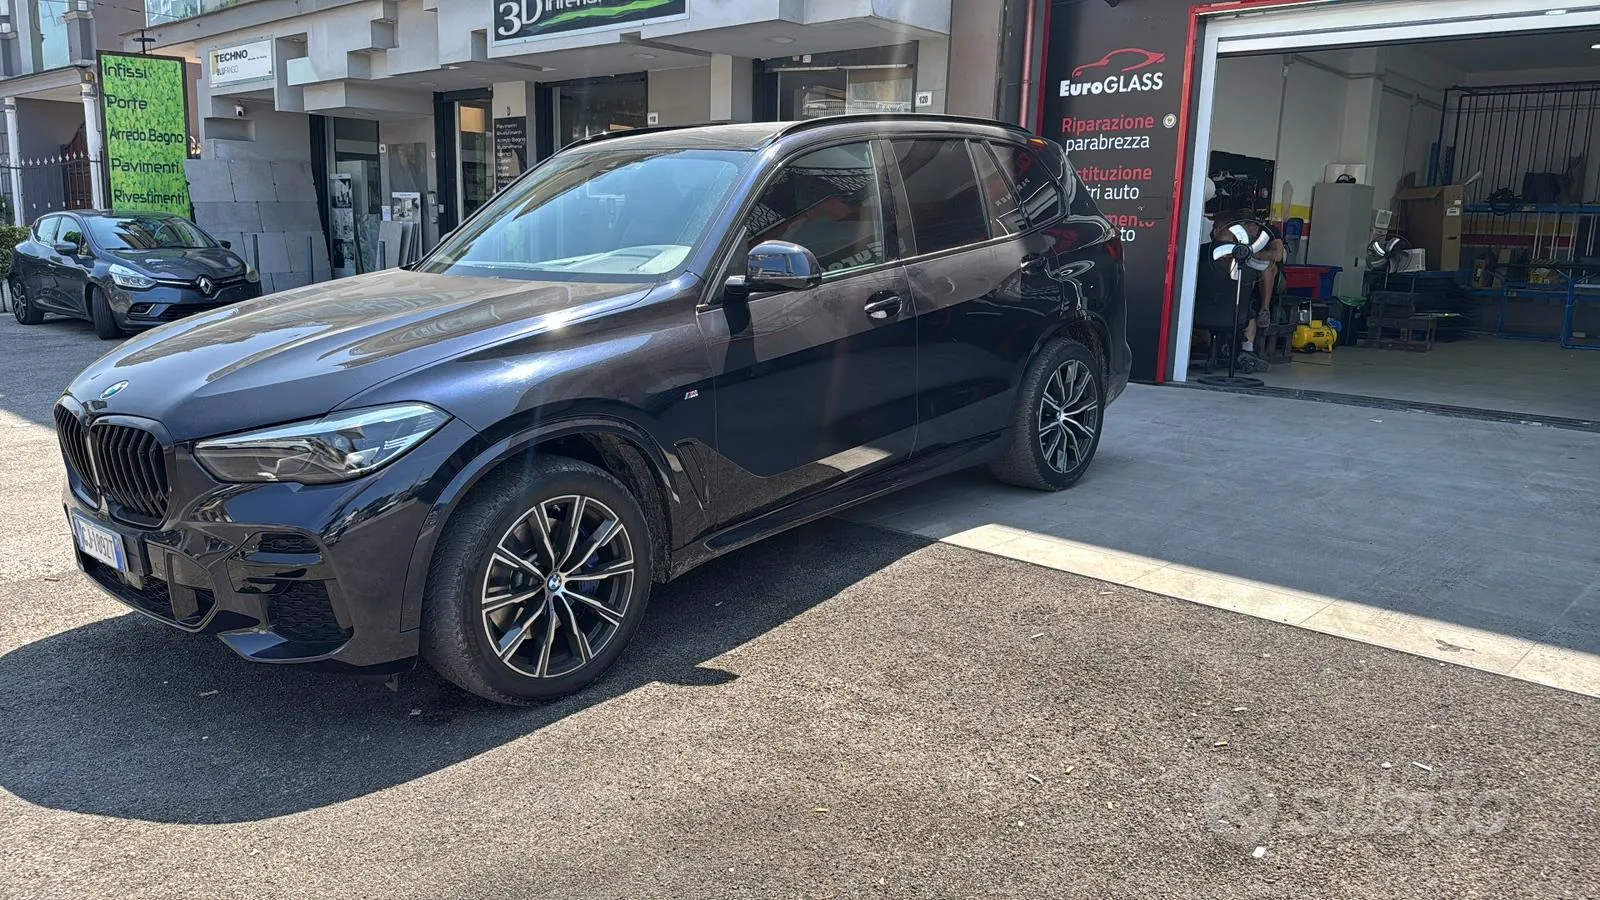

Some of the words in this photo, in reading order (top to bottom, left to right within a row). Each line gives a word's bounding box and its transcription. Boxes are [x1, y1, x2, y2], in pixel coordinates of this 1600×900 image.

[498, 0, 543, 36] 3D
[214, 49, 248, 63] TECHNO
[104, 62, 147, 79] Infissi
[1059, 72, 1164, 97] EuroGLASS
[105, 94, 148, 110] Porte
[919, 95, 929, 104] 120
[1062, 114, 1155, 136] Riparazione
[109, 127, 147, 142] Arredo
[148, 129, 184, 146] Bagno
[1066, 133, 1151, 156] parabrezza
[111, 157, 180, 174] Pavimenti
[114, 189, 185, 205] Rivestimenti
[1104, 185, 1140, 199] auto
